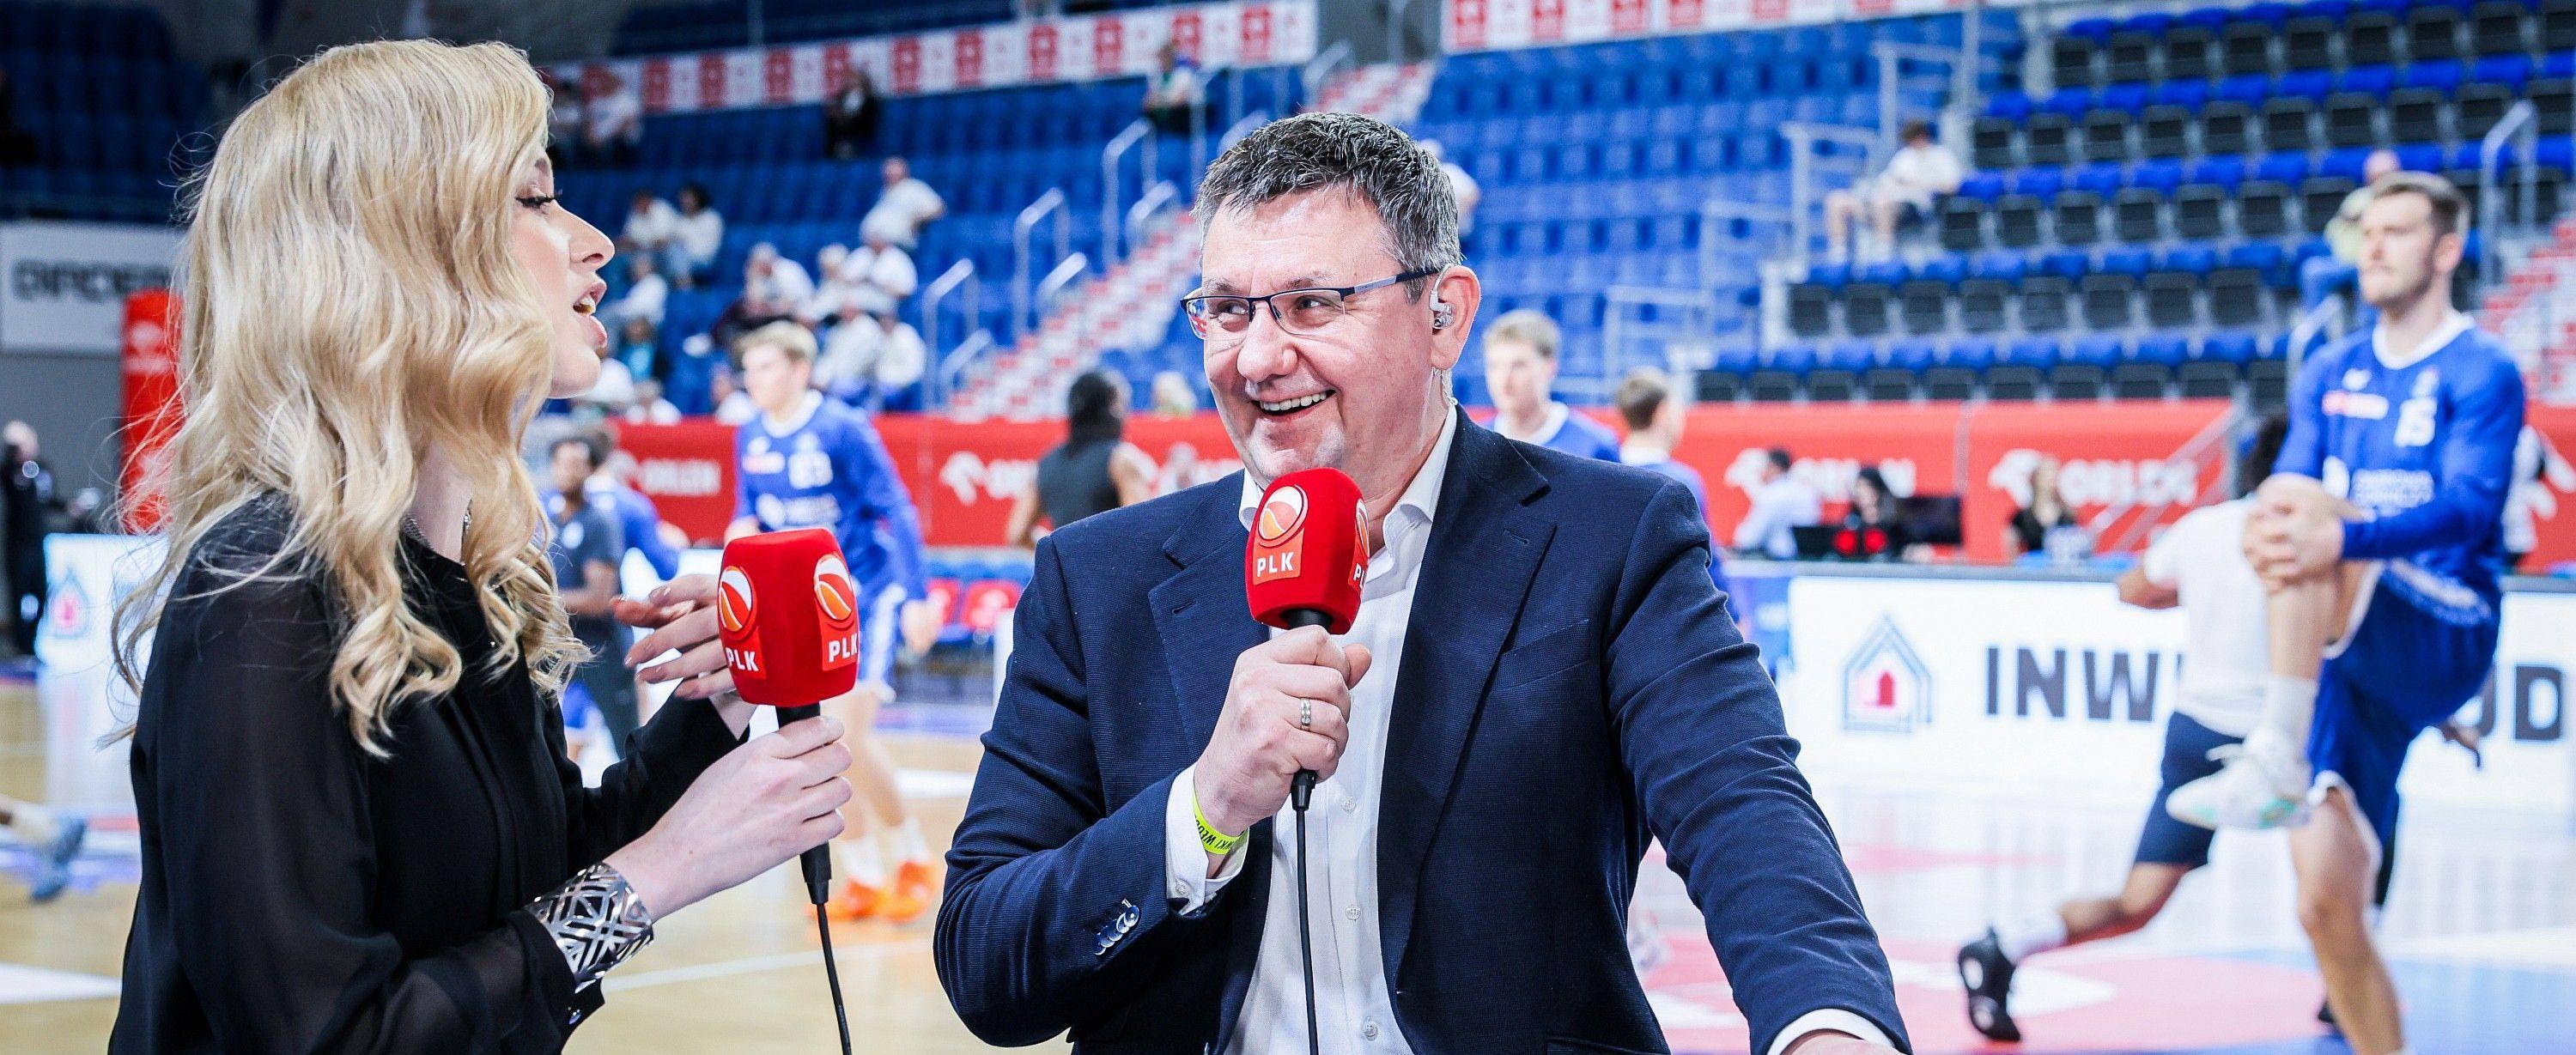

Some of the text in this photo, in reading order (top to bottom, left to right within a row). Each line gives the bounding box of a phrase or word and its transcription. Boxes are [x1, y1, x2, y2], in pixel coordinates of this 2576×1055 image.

[1256, 551, 1294, 577] PLK
[725, 646, 759, 672] PLK
[828, 633, 858, 664] PLK
